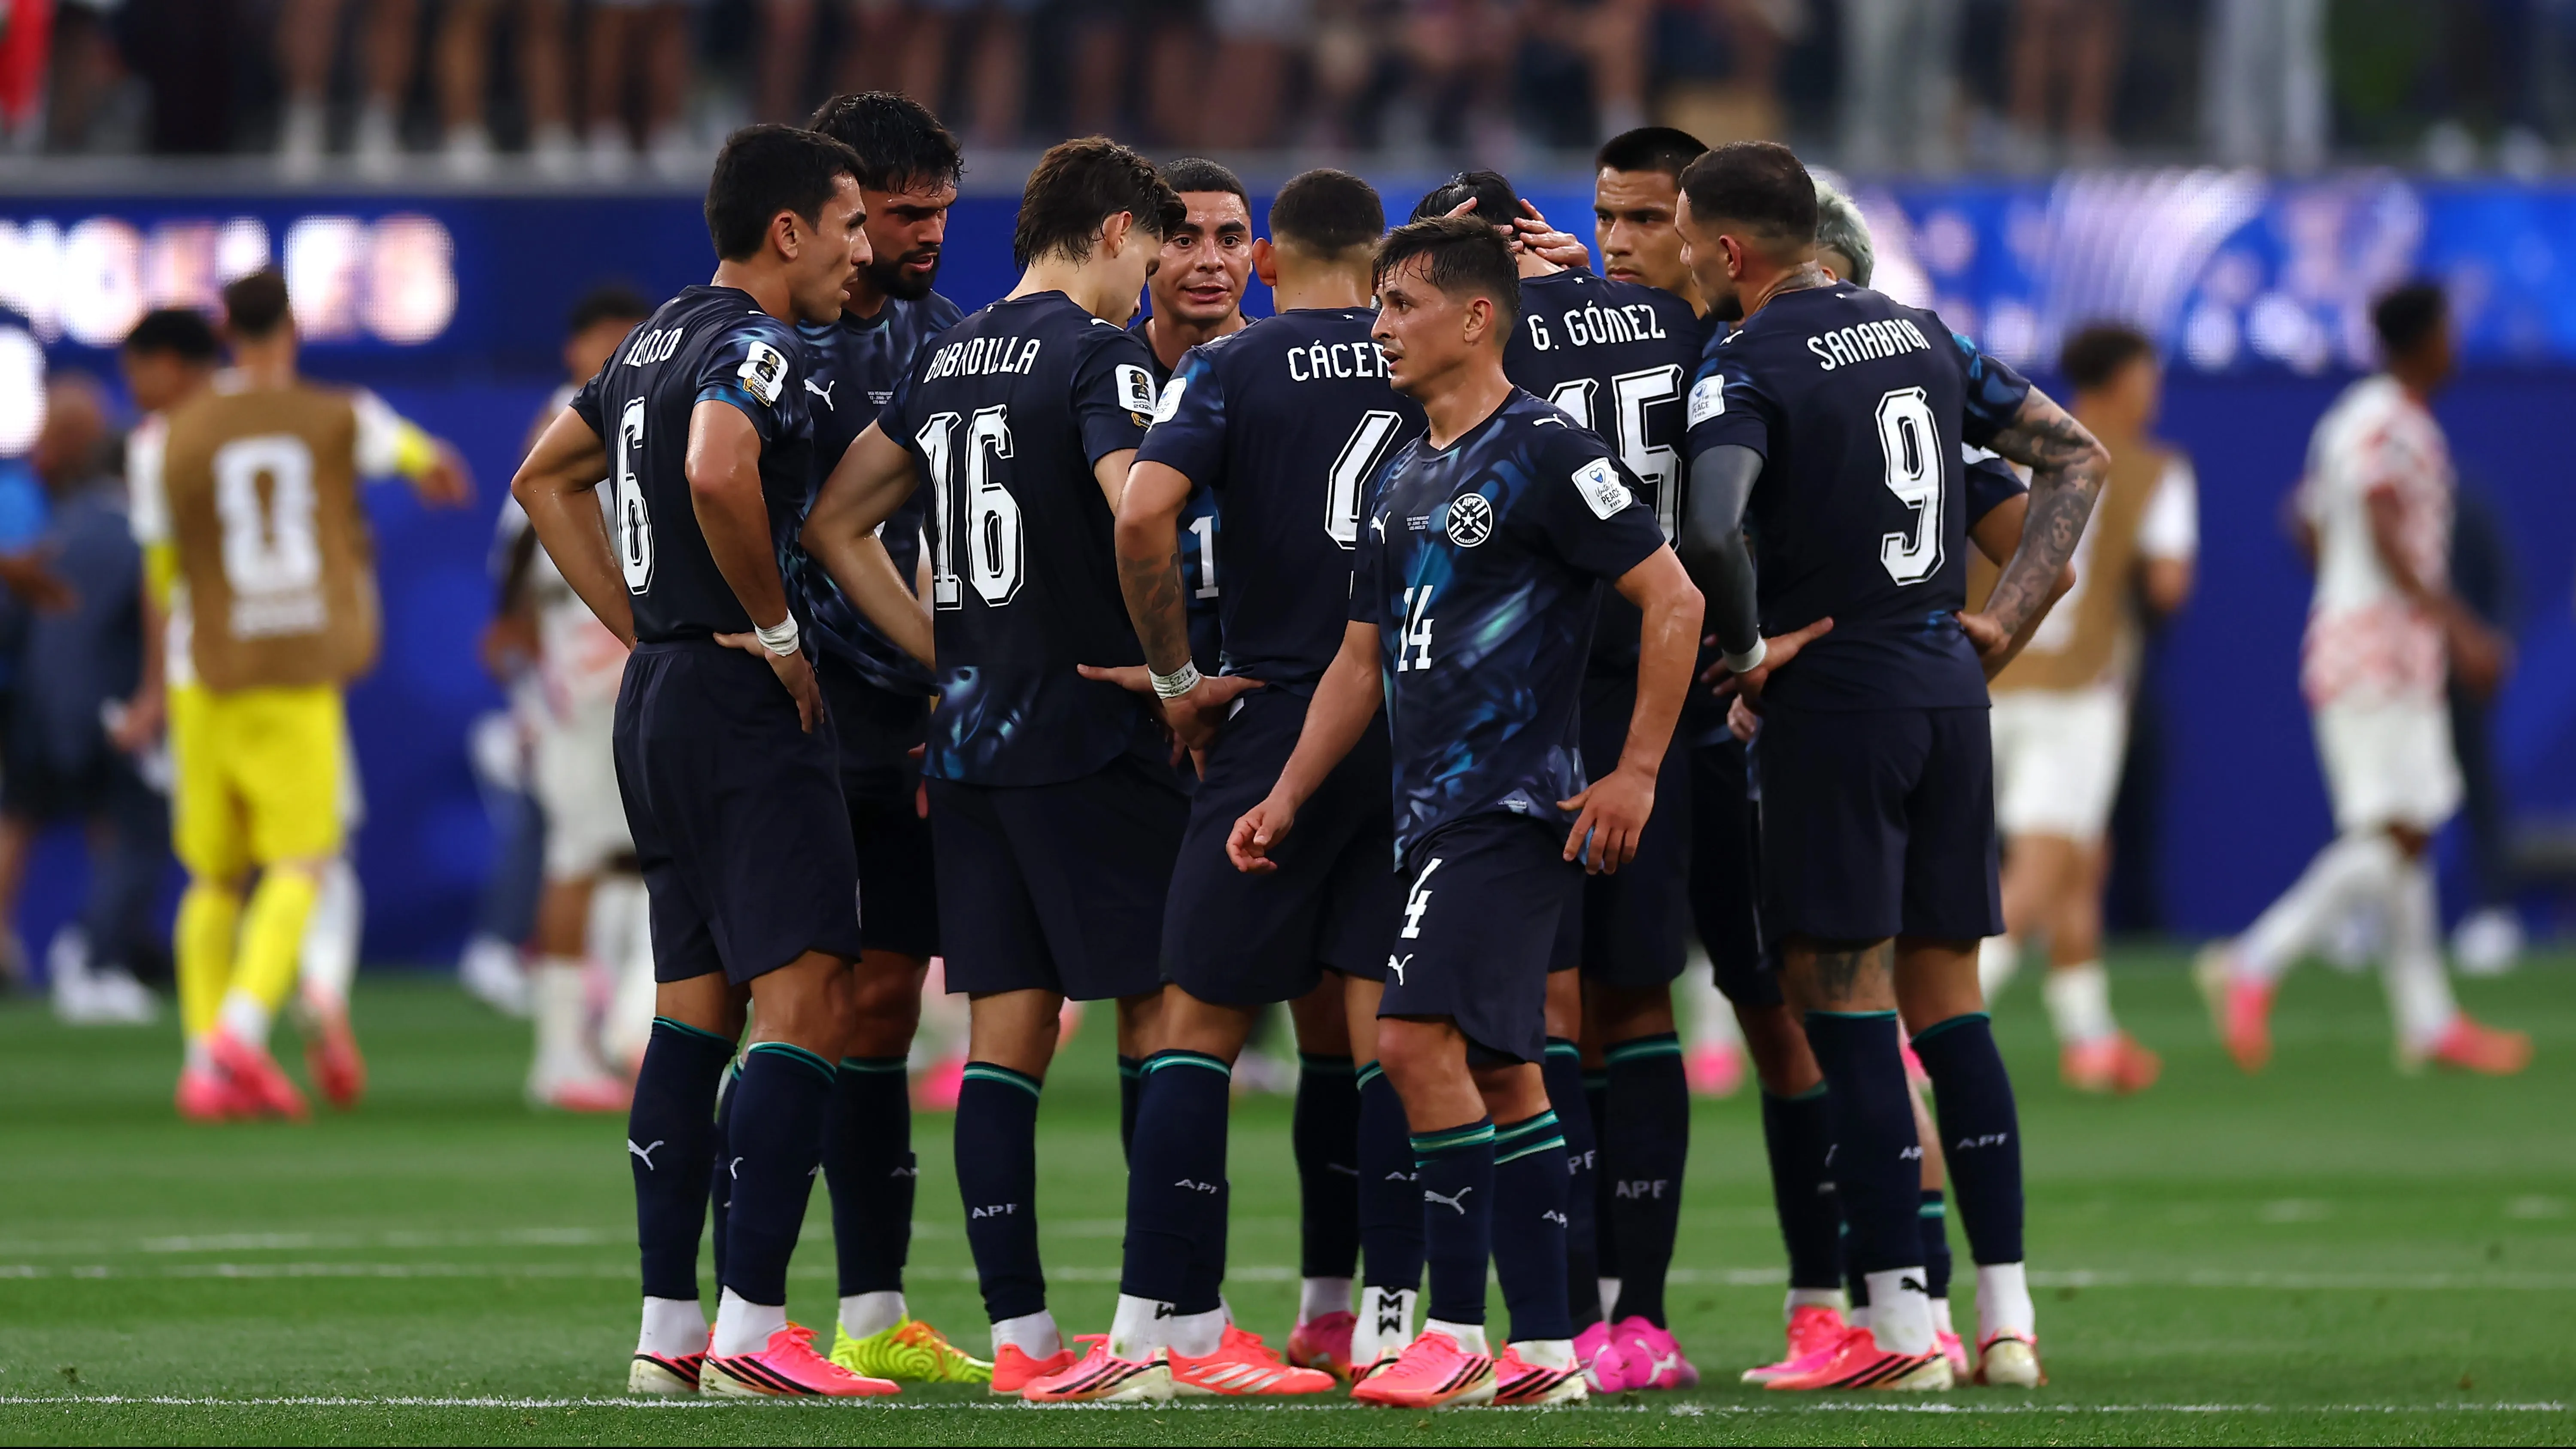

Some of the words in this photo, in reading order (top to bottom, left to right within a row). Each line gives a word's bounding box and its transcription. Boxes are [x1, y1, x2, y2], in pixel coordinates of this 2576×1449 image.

[1527, 315, 1559, 350] G.
[1563, 300, 1666, 346] GÓMEZ
[1807, 319, 1931, 371] SANABRIA
[759, 369, 769, 379] FIFA
[923, 337, 1041, 383] BOBADILLA
[617, 396, 654, 595] 6
[915, 404, 1024, 610] 16
[1601, 488, 1621, 505] PEACE
[1610, 499, 1622, 508] FIFA
[1875, 386, 1945, 586] 9
[1456, 536, 1479, 544] PARAGUAY
[1397, 585, 1434, 672] 14
[972, 1203, 1018, 1219] APF
[1616, 1179, 1668, 1199] APF
